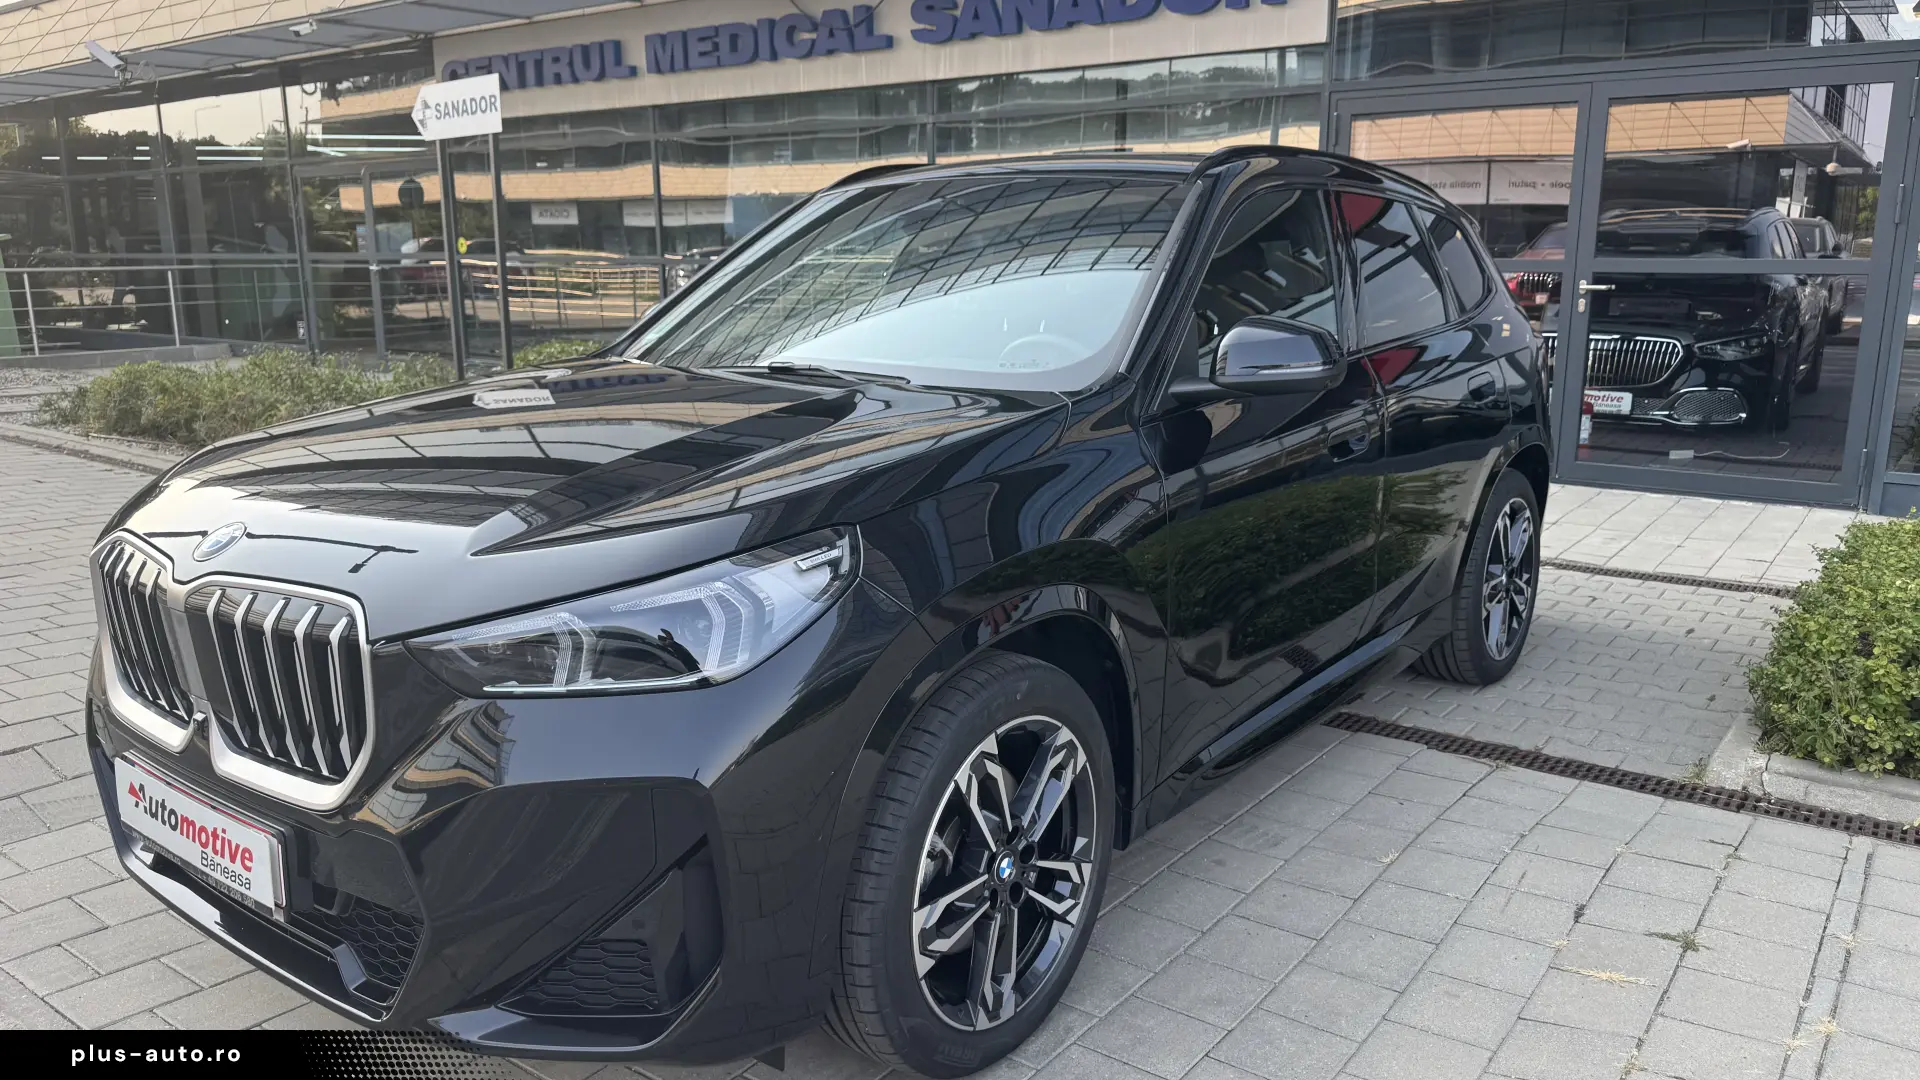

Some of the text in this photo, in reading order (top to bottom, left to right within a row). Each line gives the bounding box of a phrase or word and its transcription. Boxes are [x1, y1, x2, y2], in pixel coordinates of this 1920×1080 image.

[645, 4, 893, 74] MEDICAL
[911, 0, 1288, 44] SANA
[434, 94, 499, 121] SANADOR
[128, 781, 254, 872] Automotive
[200, 849, 251, 891] Băneasa
